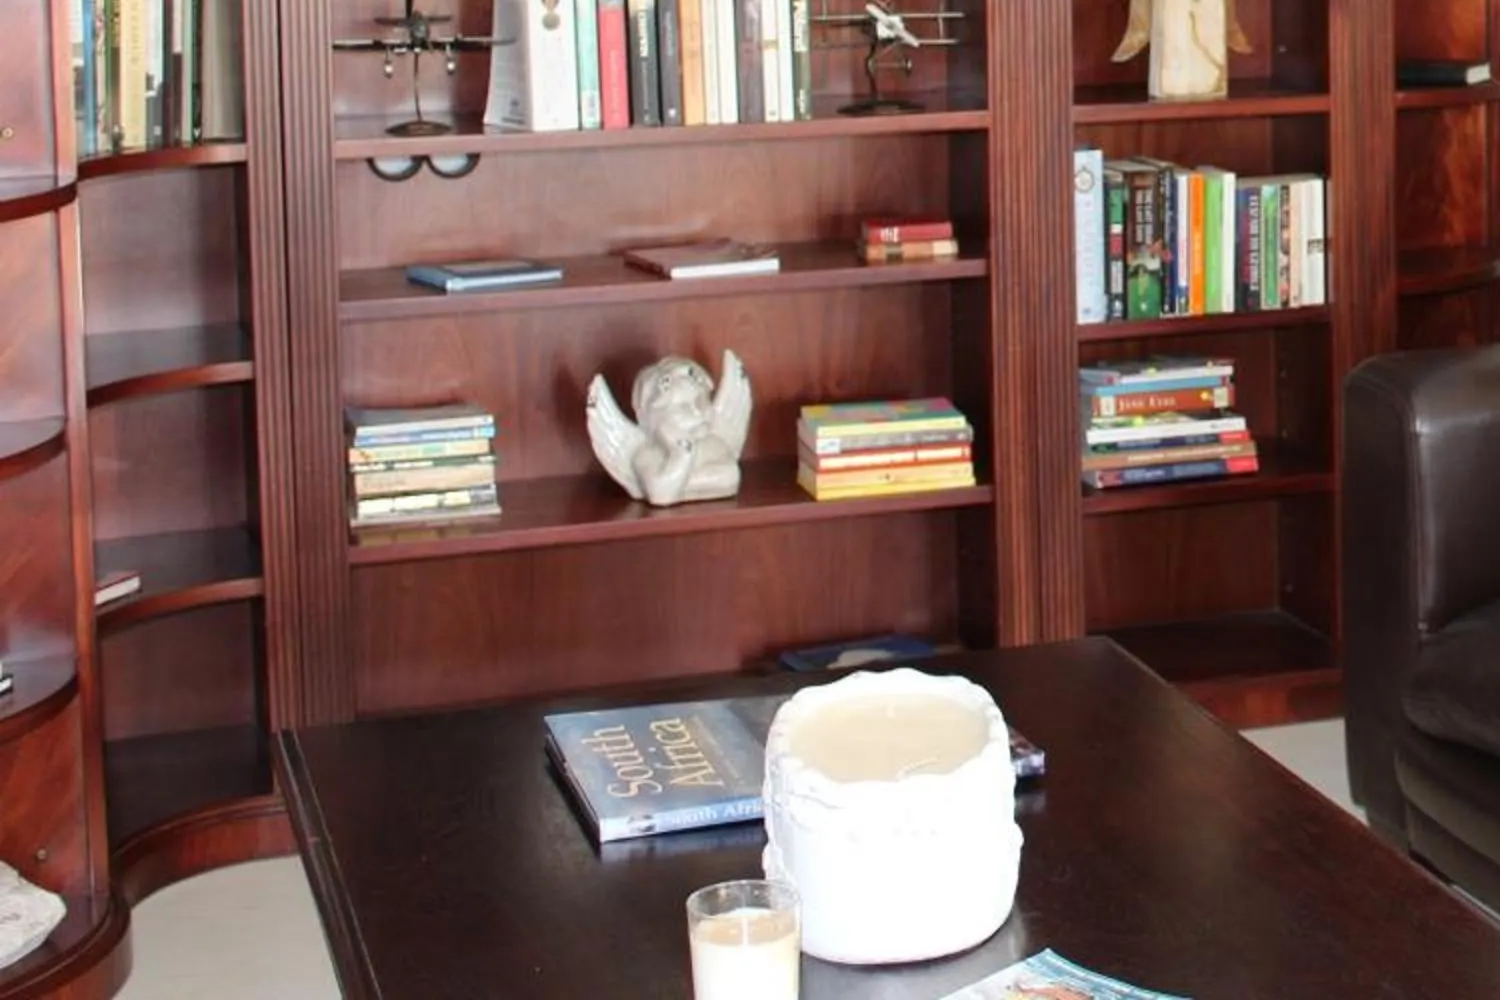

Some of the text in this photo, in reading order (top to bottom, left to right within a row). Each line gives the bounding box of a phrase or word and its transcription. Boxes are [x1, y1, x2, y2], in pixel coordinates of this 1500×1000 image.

[581, 724, 663, 798] South
[650, 717, 724, 787] Africa
[662, 806, 717, 827] South
